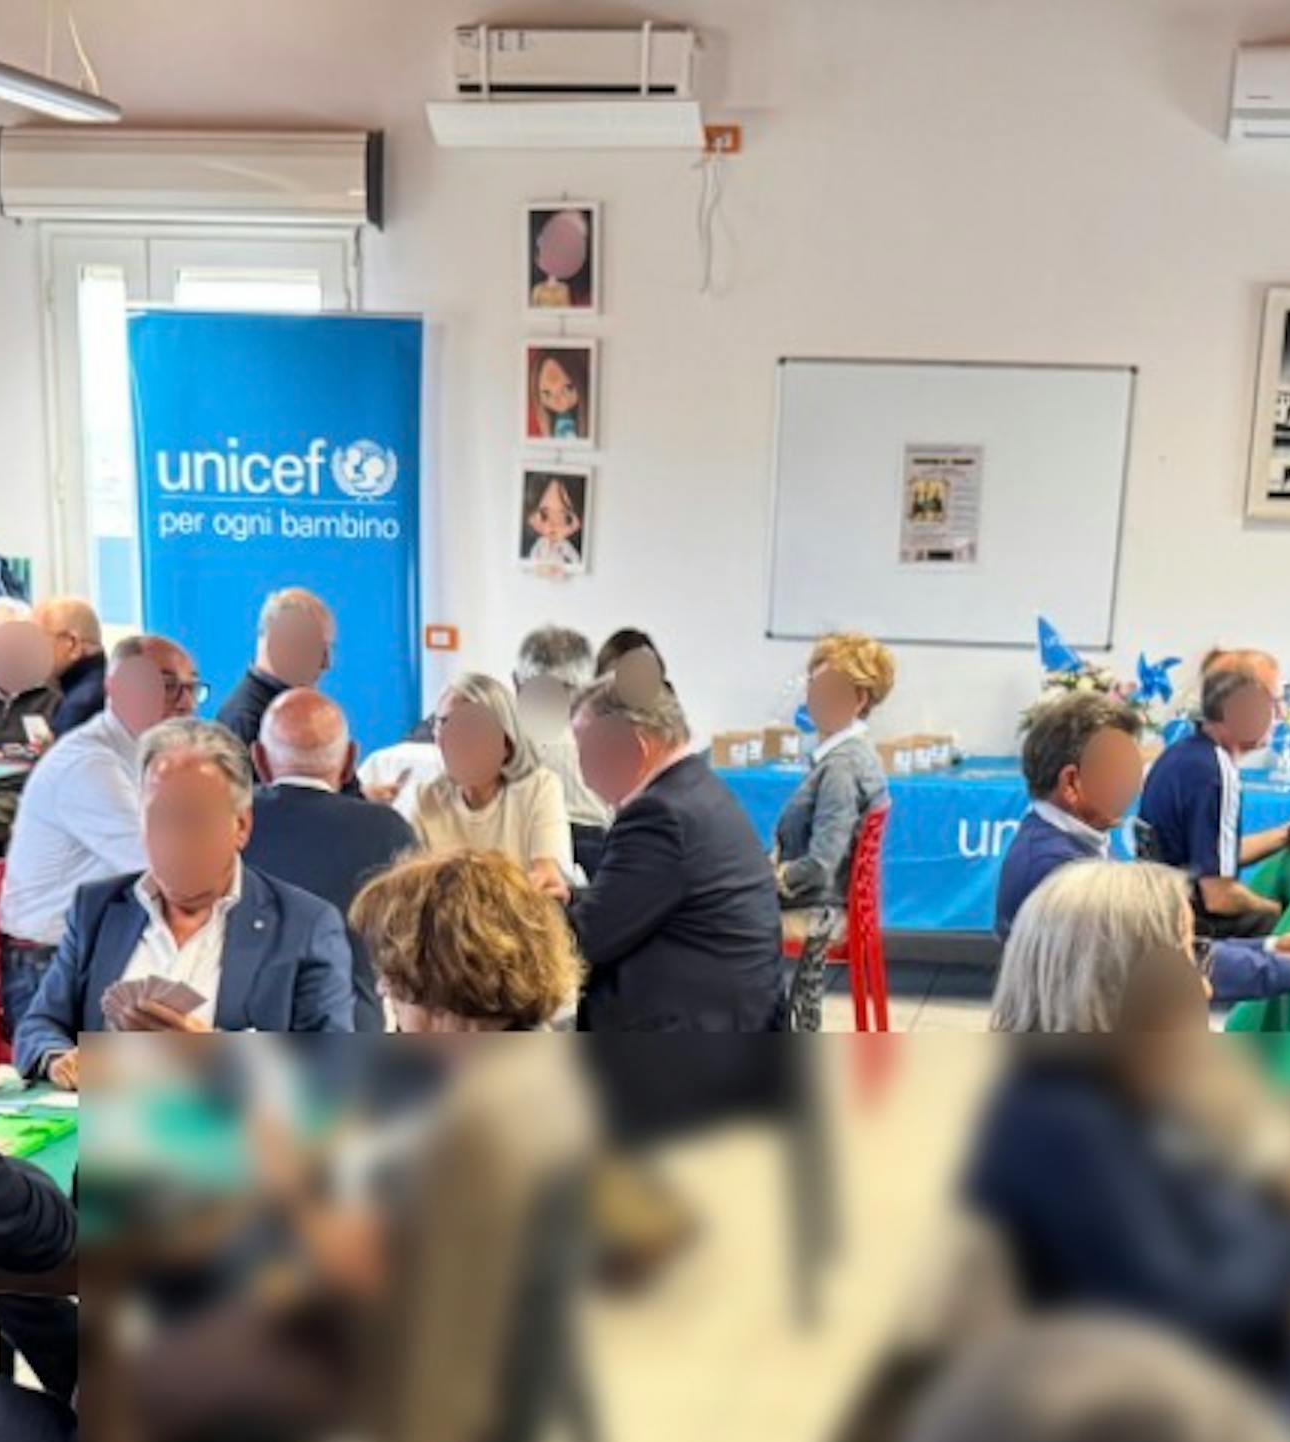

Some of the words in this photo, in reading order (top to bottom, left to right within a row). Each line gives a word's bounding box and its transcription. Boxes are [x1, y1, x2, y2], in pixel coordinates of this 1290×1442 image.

[156, 437, 328, 495] unicef
[159, 511, 206, 539] per
[212, 507, 273, 542] ogni
[280, 508, 401, 541] bambino
